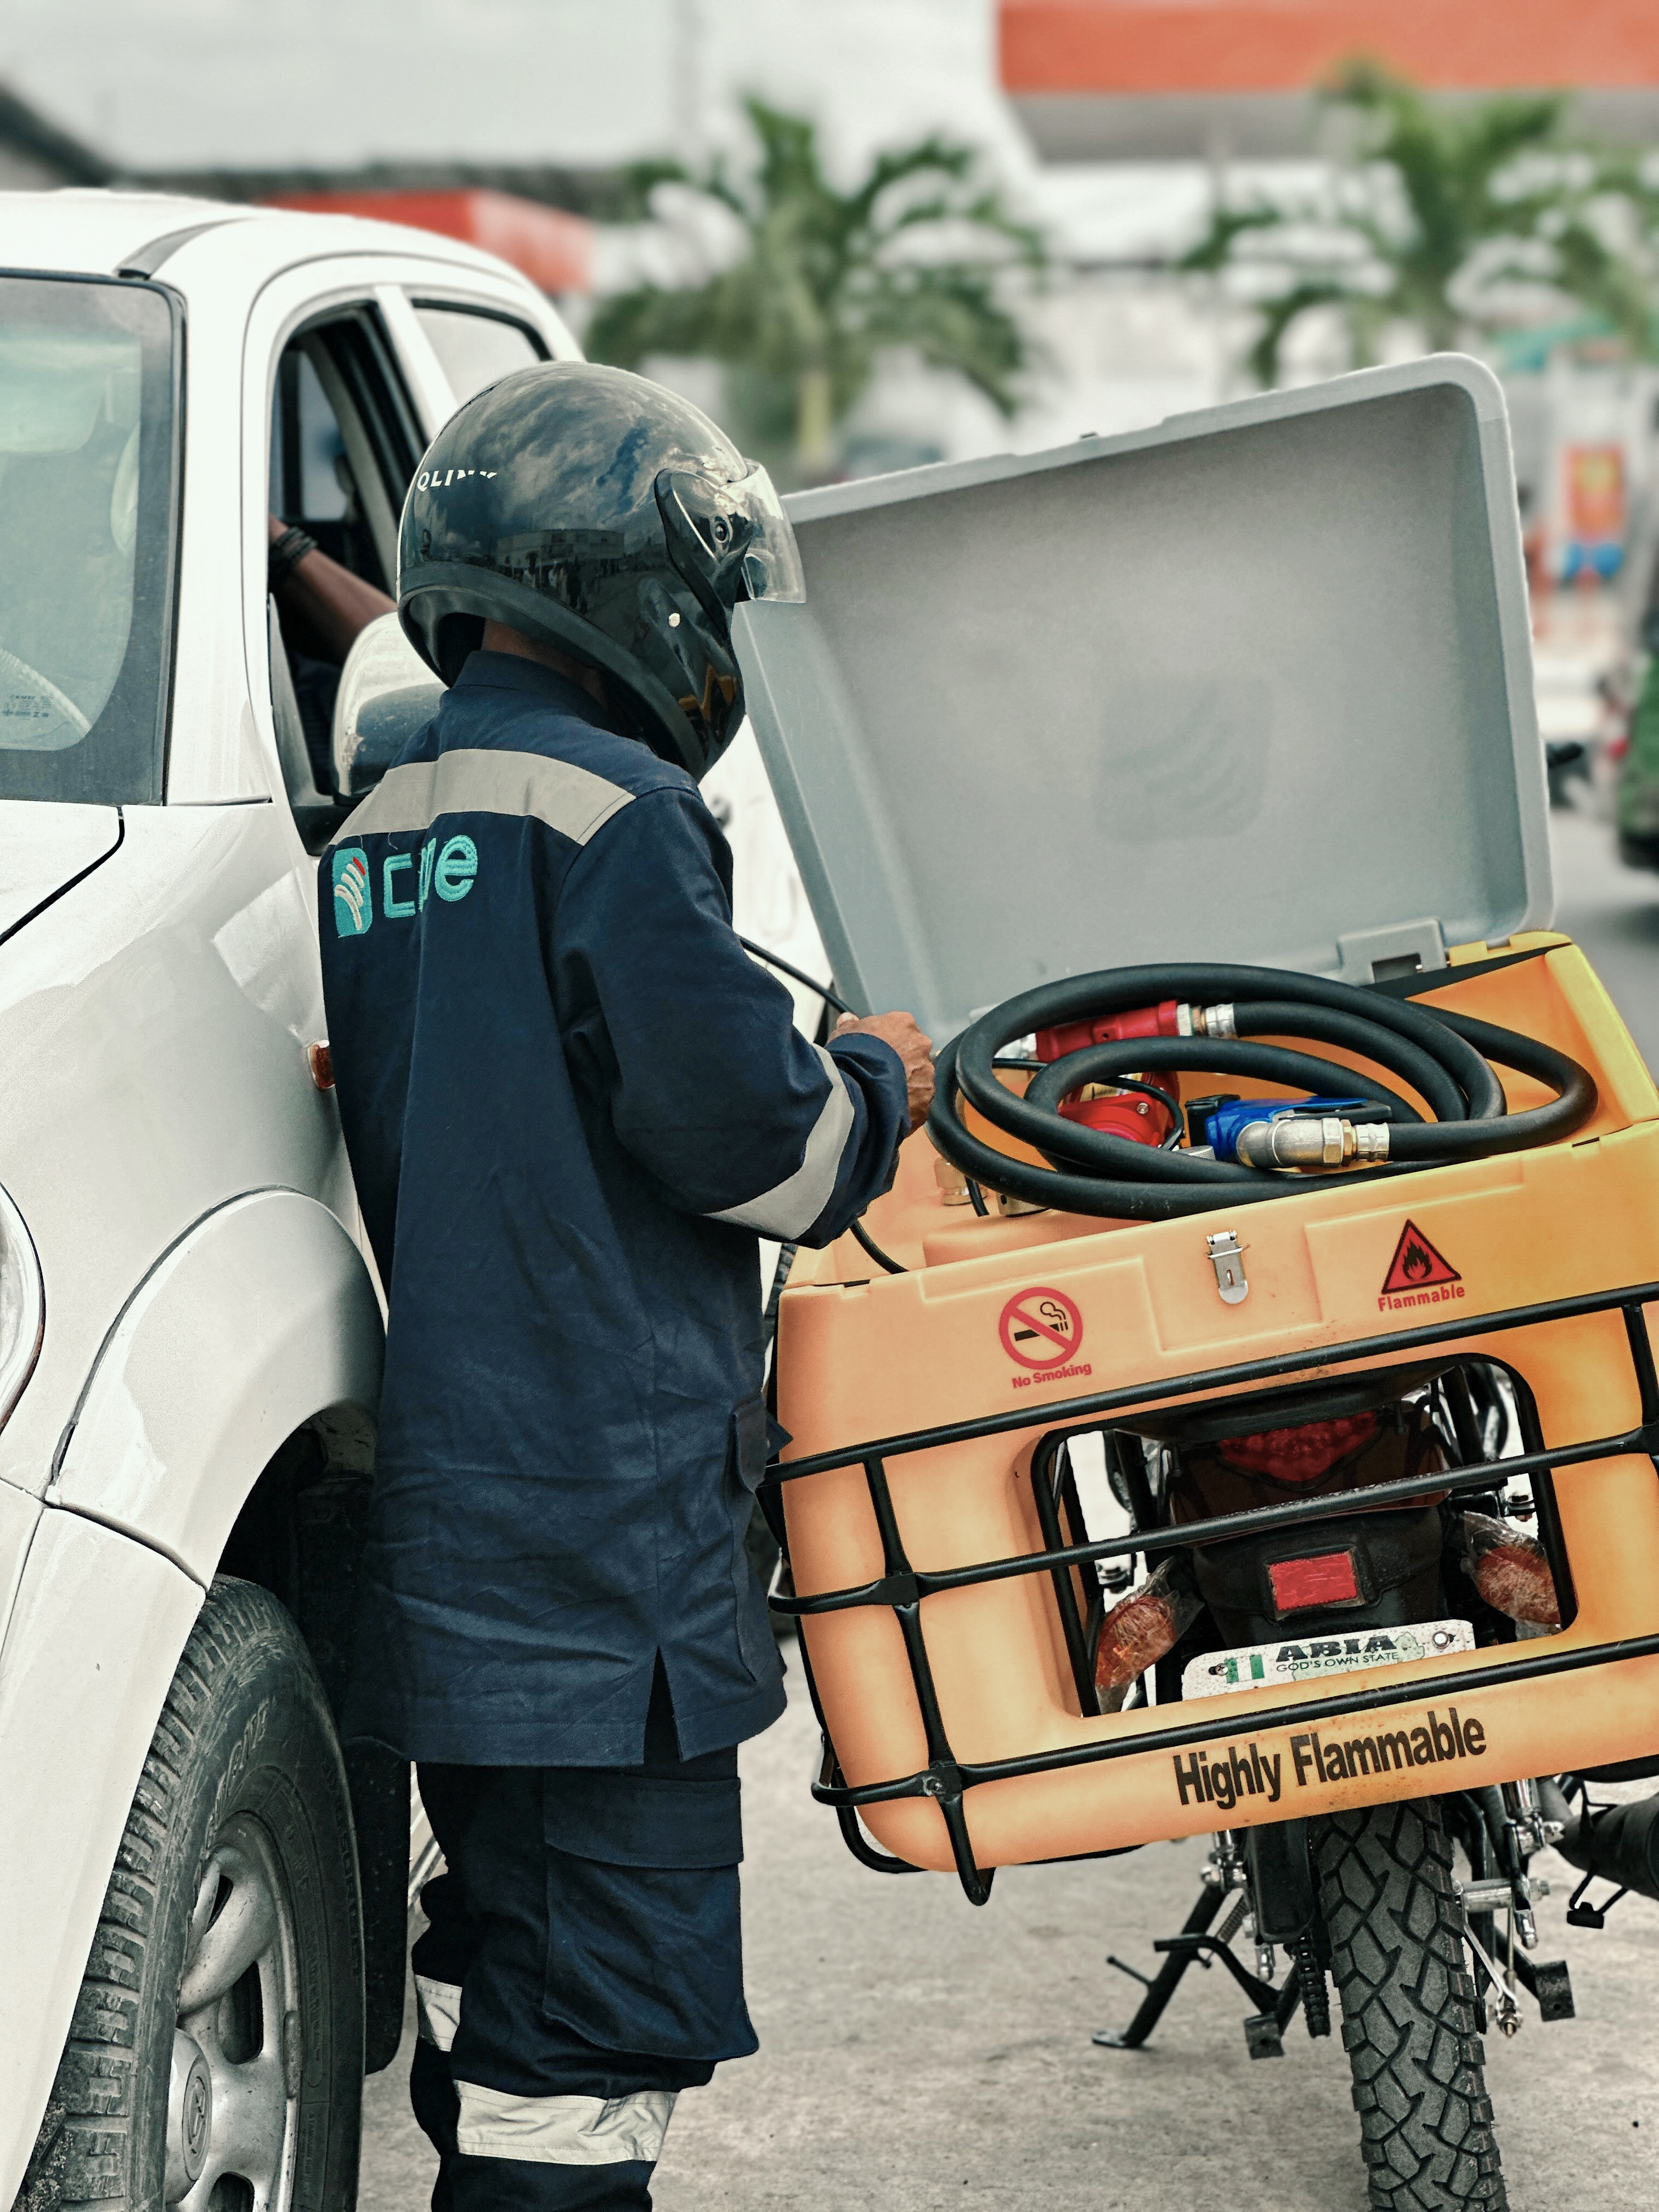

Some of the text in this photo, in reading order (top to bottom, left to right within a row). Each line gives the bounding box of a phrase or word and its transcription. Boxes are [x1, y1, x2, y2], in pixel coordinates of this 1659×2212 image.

[1378, 1284, 1465, 1311] Flammable
[1012, 1364, 1092, 1388] No Smoking
[1276, 1635, 1397, 1662] ABIA
[1276, 1652, 1399, 1672] GOD'S OWN STATE
[1173, 1707, 1487, 1810] Highly Flammable
